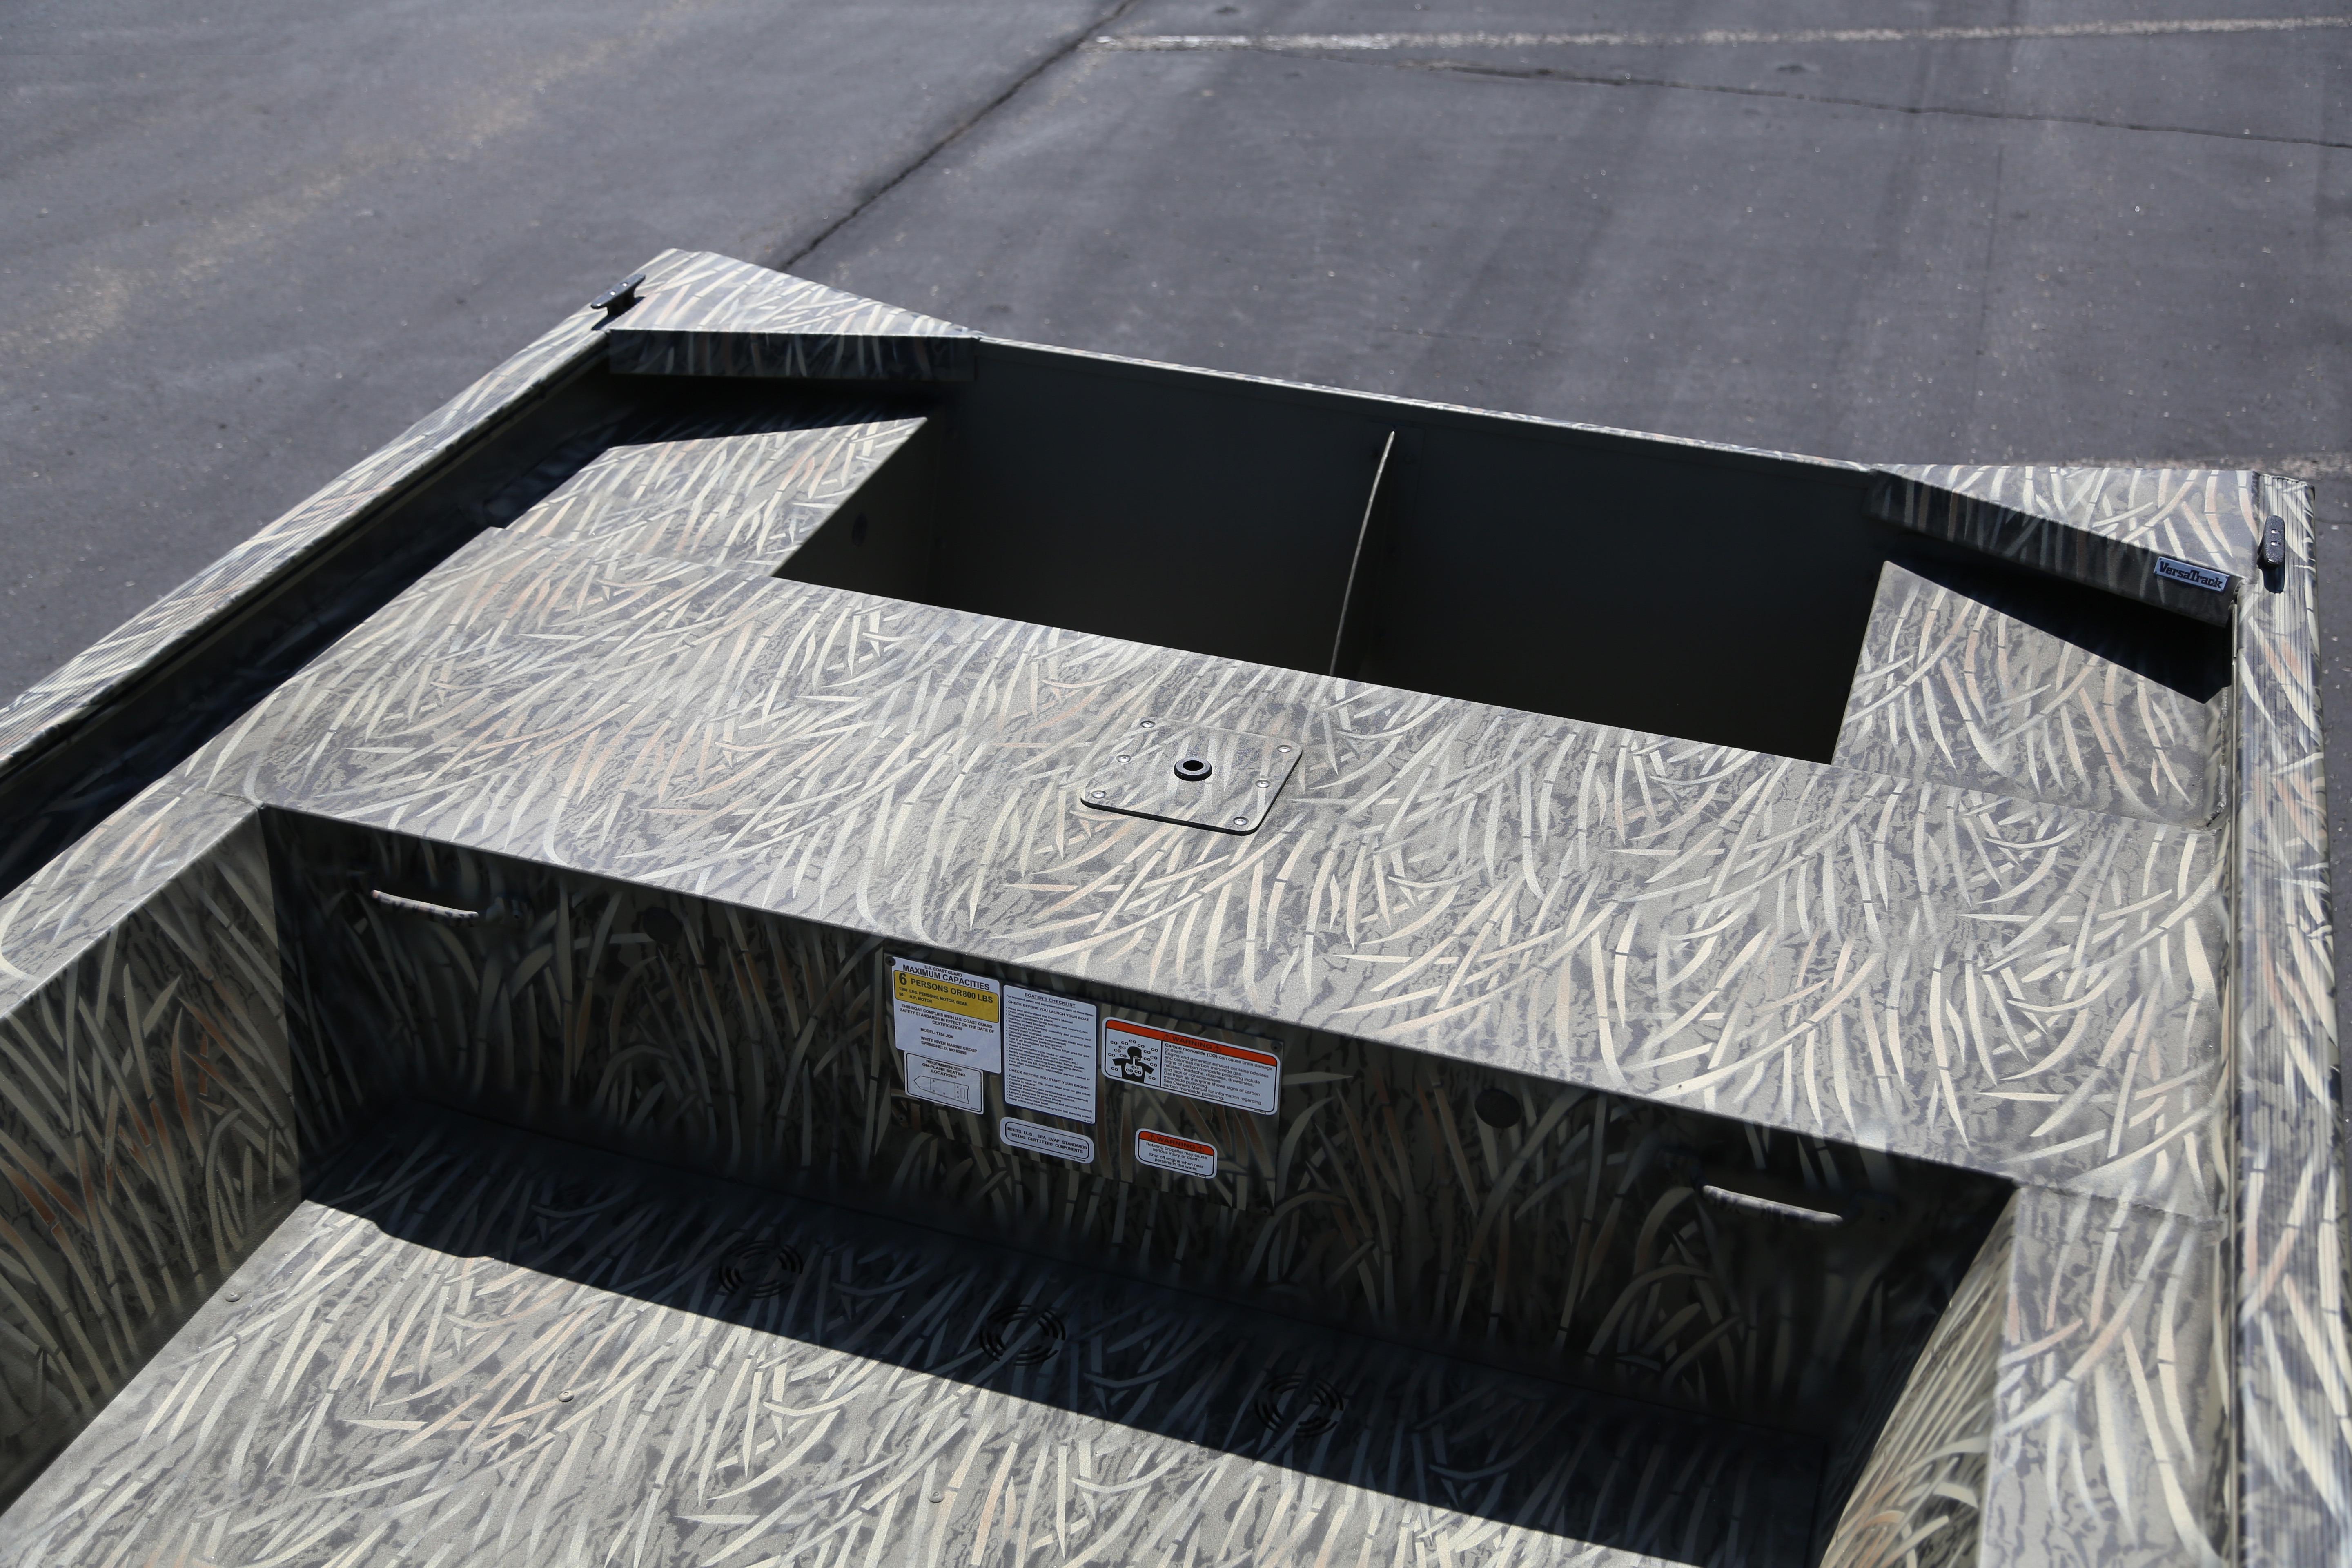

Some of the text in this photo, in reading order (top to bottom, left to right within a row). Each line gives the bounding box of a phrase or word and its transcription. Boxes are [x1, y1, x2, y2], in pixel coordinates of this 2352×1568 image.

[2159, 561, 2223, 588] VersaTrack
[898, 972, 907, 985] 6
[902, 964, 989, 990] MAXIMUM CAPACITIES
[911, 978, 993, 1003] PERSONS OR 800 LBS
[918, 991, 939, 1000] PERSONS,
[1048, 998, 1076, 1007] CHECKLIST
[915, 1011, 940, 1021] STANDARDS
[922, 1009, 943, 1017] COMPLIES
[932, 1020, 962, 1031] CERTIFICATION
[921, 1040, 948, 1051] SPRINGFIELD,
[1172, 1036, 1212, 1049] WARNING
[1183, 1047, 1205, 1056] monoxide
[922, 1062, 966, 1077] ON-PLANE SEATING
[926, 1059, 962, 1071] RECOMMENDED
[1210, 1066, 1232, 1074] monoxide
[931, 1069, 957, 1079] LOCATIONS
[1182, 1067, 1205, 1076] headache,
[1205, 1073, 1227, 1081] dizziness,
[1227, 1078, 1254, 1087] drowsiness,
[1188, 1073, 1221, 1083] consciousness.
[1221, 1072, 1243, 1081] poisoning
[1185, 1080, 1208, 1089] poisoning.
[1179, 1087, 1201, 1095] monoxide
[1201, 1092, 1224, 1100] poisoning.
[1215, 1090, 1239, 1100] information
[1240, 1097, 1261, 1105] regarding
[1027, 1136, 1053, 1146] CERTIFIED
[1055, 1143, 1083, 1154] COMPONENTS
[1062, 1140, 1087, 1149] STANDARDS
[1146, 1141, 1163, 1150] Rotating
[1156, 1136, 1195, 1150] WARNING
